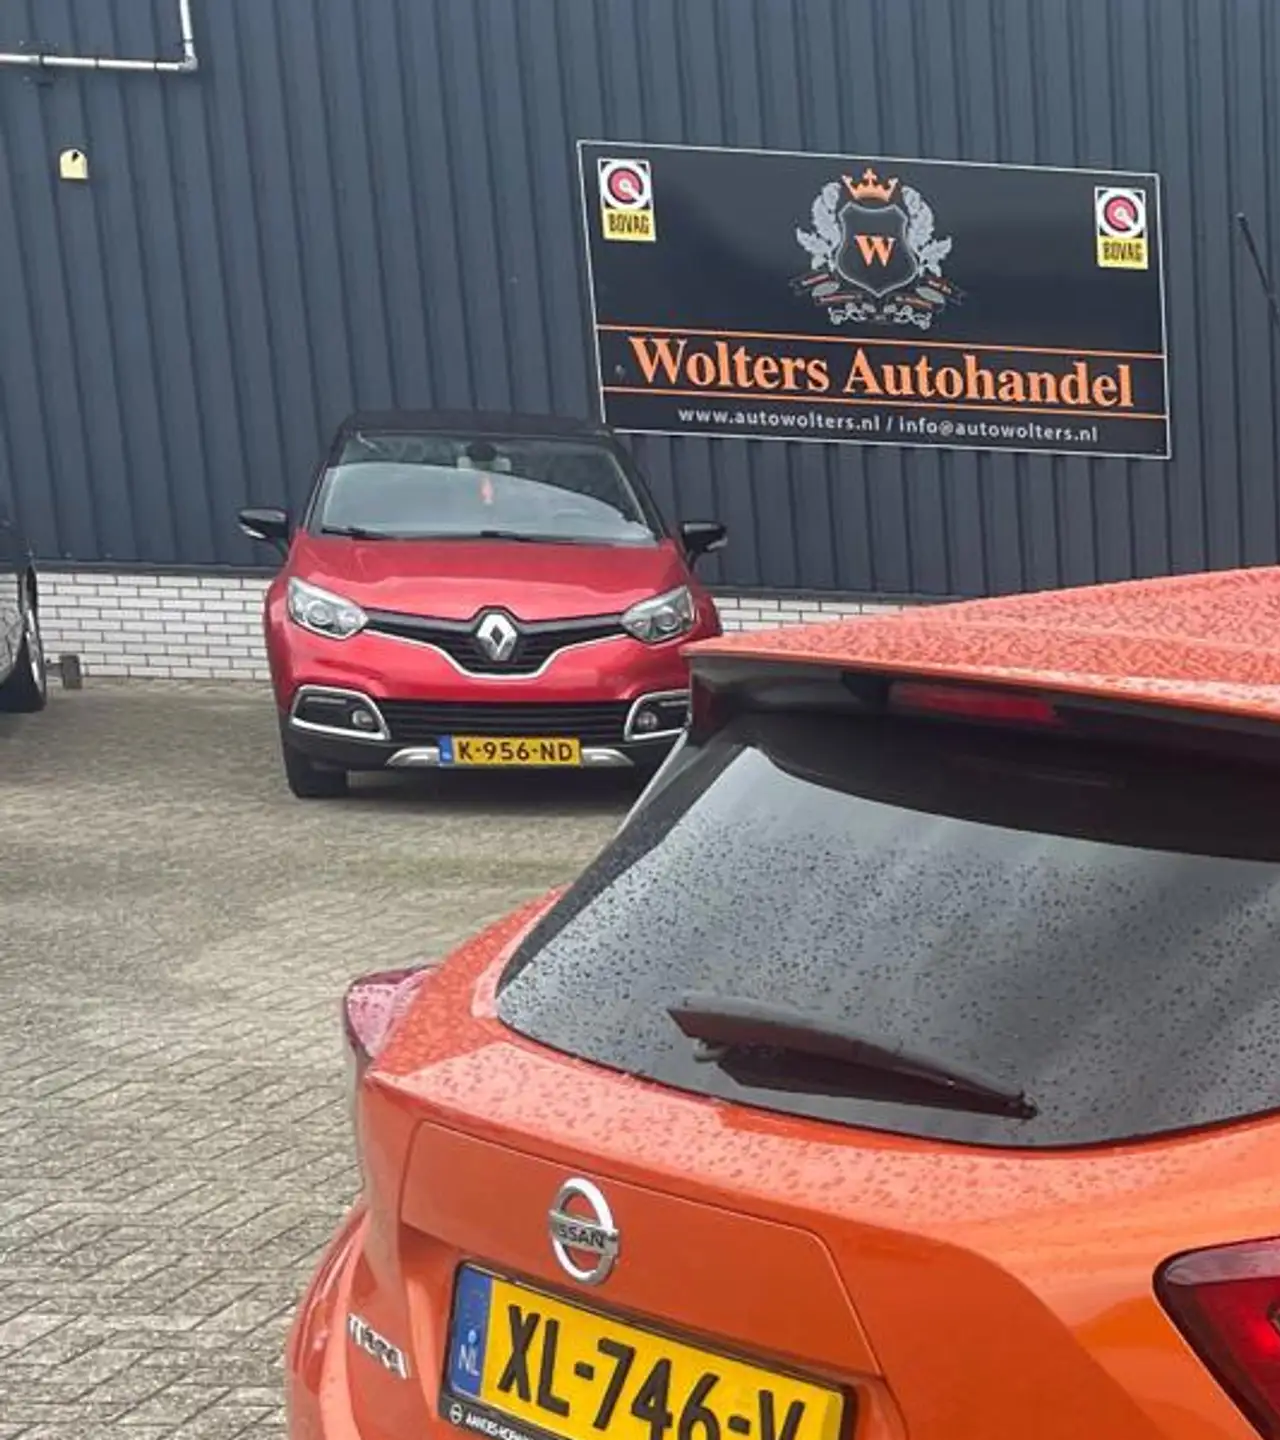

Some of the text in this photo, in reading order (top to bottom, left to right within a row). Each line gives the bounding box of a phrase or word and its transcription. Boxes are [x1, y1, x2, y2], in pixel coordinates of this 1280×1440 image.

[608, 212, 651, 235] BOVAG
[855, 234, 895, 267] W
[1102, 241, 1144, 263] BOVAG
[628, 336, 1134, 407] Wolters Autohandel
[678, 406, 880, 432] www.autowolters.nl
[900, 416, 1098, 442] info@autowolters.nl
[457, 741, 573, 762] K-956-ND
[553, 1215, 605, 1248] SSAN
[458, 1343, 481, 1377] NL
